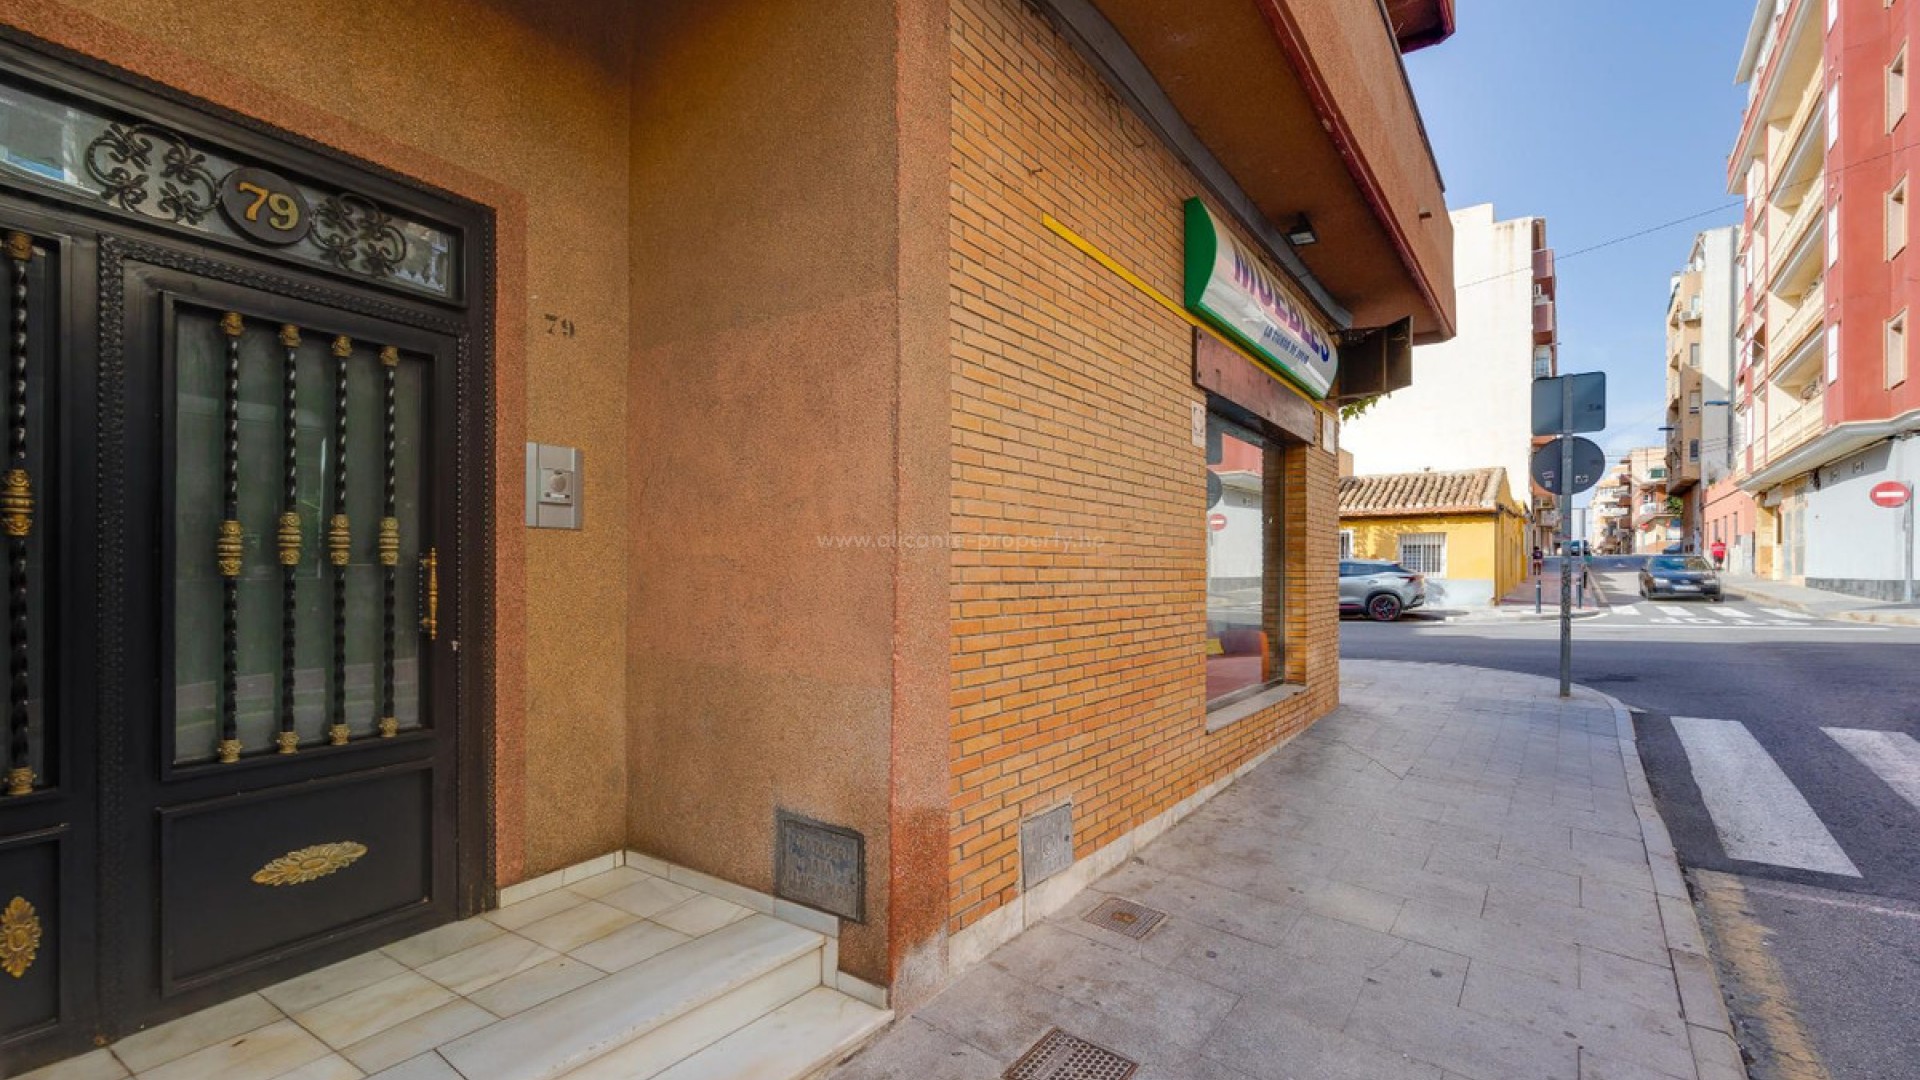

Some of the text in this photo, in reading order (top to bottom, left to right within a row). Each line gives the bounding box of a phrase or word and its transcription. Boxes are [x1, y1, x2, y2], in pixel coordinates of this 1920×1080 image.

[238, 182, 299, 231] 79
[1232, 238, 1330, 363] MUEBLES
[543, 313, 575, 338] 79
